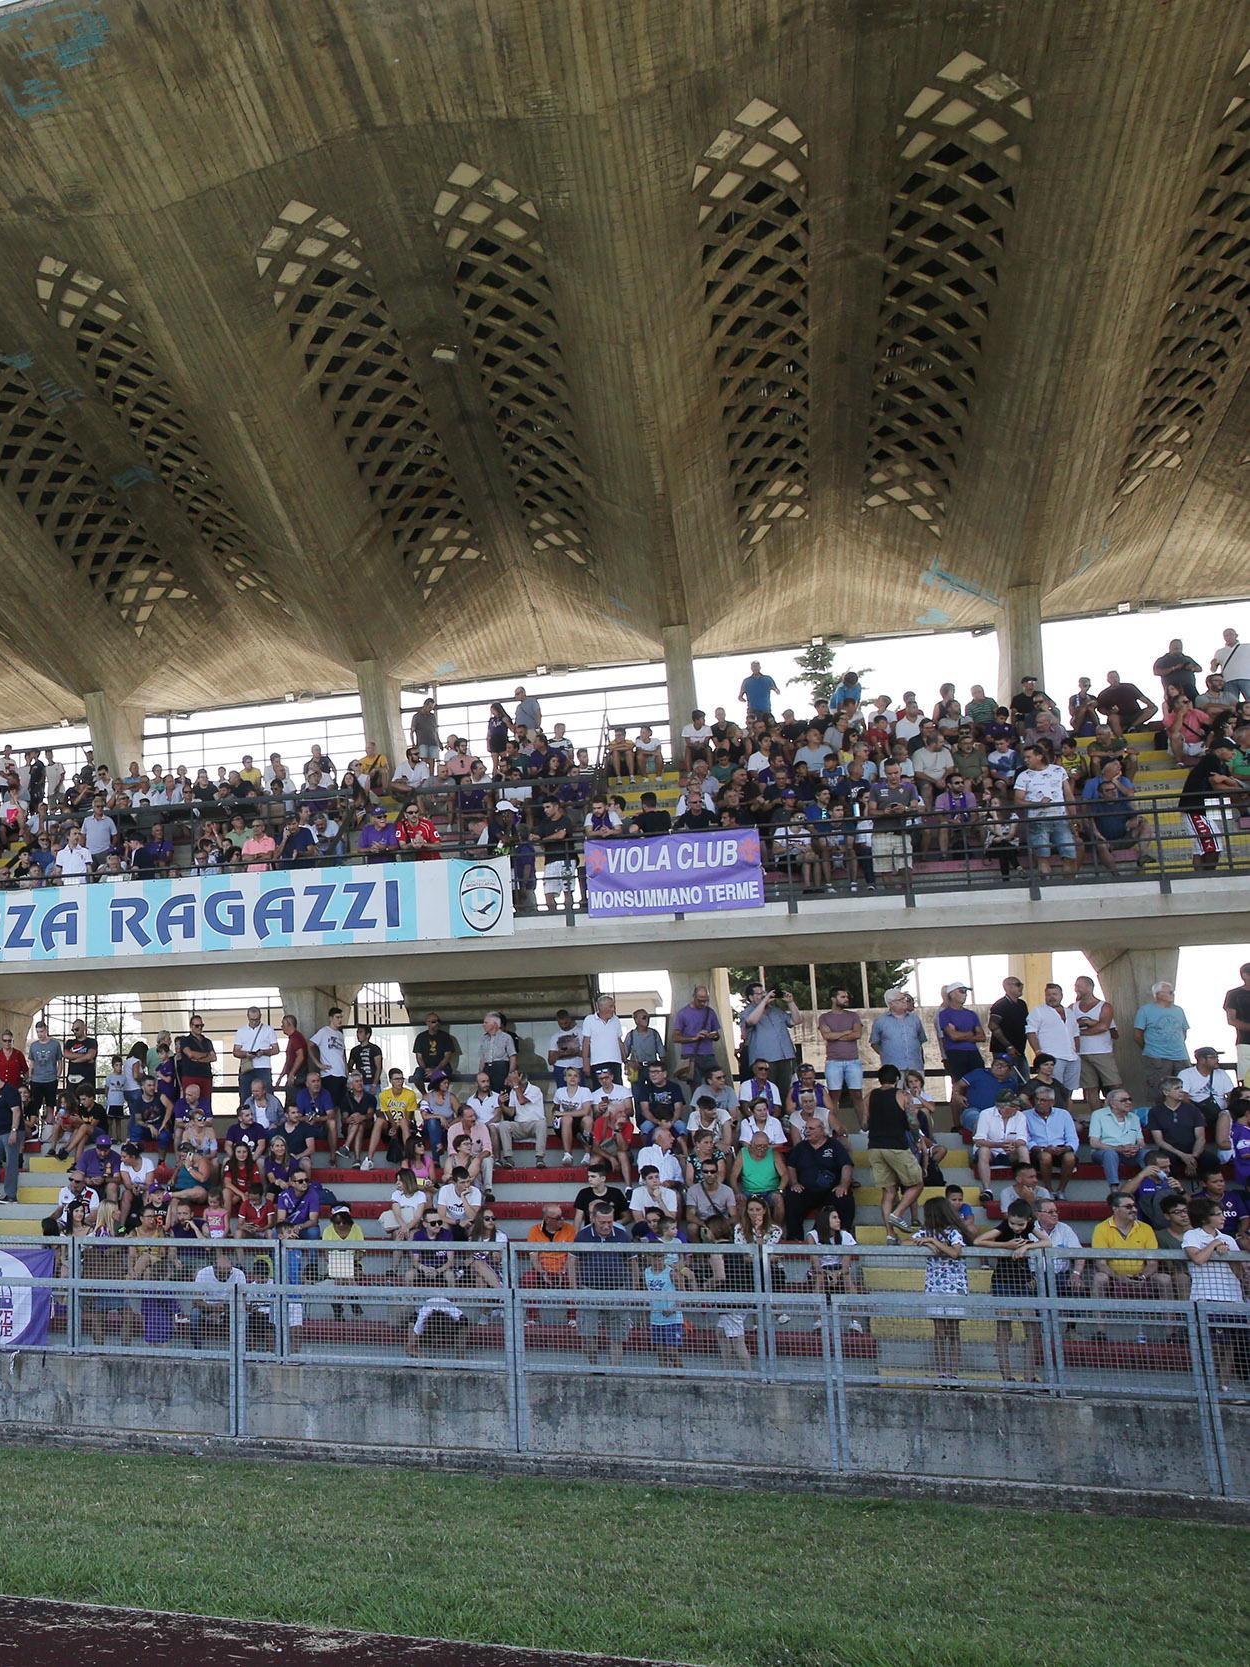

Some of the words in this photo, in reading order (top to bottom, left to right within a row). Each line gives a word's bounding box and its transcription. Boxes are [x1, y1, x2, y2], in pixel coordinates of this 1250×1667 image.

[606, 844, 671, 873] VIOLA
[677, 839, 739, 870] CLUB
[590, 886, 703, 909] MONSUMMANO
[705, 881, 760, 902] TERME
[109, 879, 401, 947] RAGAZZI
